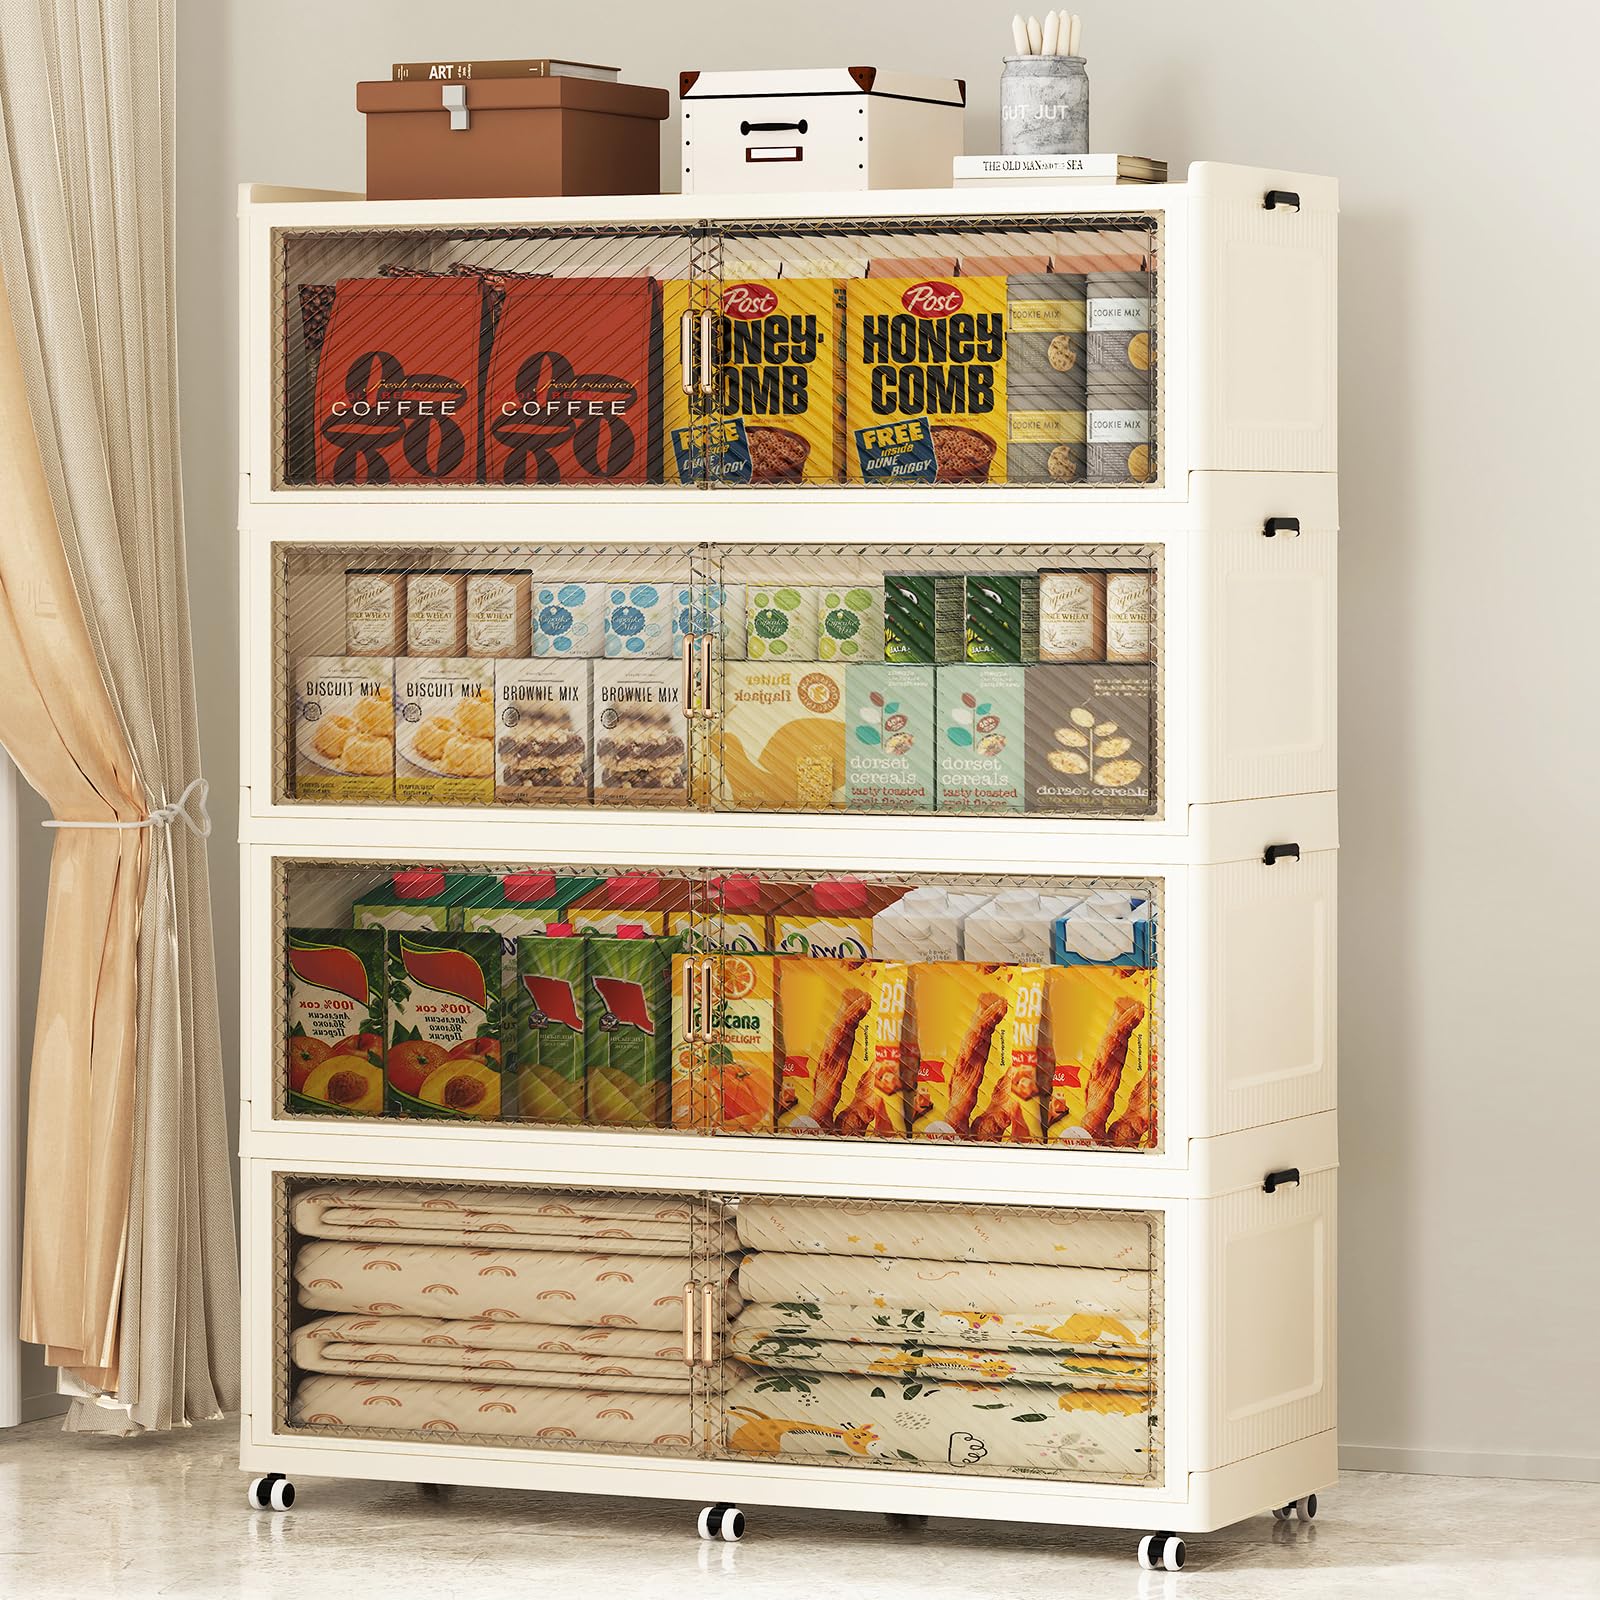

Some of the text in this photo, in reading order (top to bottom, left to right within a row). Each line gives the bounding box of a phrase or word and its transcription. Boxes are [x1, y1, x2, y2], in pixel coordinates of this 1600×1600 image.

[428, 65, 454, 79] ART
[1034, 104, 1069, 120] JUT
[983, 161, 1001, 171] THE
[1002, 160, 1021, 171] OLD
[1022, 160, 1041, 171] MAN
[1066, 159, 1084, 170] SEA
[724, 288, 775, 313] Post
[907, 286, 960, 312] Post
[1013, 311, 1060, 319] COOKIE MIX
[1094, 309, 1141, 317] COOKIE MIX
[363, 379, 470, 392] fresh roasted
[533, 379, 640, 392] fresh roasted
[871, 365, 995, 415] COMB
[332, 401, 456, 416] COFFEE
[502, 401, 626, 416] COFFEE
[1012, 421, 1060, 430] COOKIE MIX
[1094, 420, 1141, 429] COOKIE MIX
[862, 421, 924, 449] FREE
[881, 443, 914, 457] inside
[866, 455, 900, 471] DUNE
[891, 459, 932, 476] BUGGY
[365, 611, 391, 619] WHEAT
[426, 612, 452, 620] WHEAT
[306, 681, 381, 697] BISCUIT MIX
[406, 682, 482, 698] BISCUIT MIX
[503, 685, 579, 701] BROWNIE MIX
[602, 686, 679, 703] BROWNIE MIX
[850, 756, 909, 770] dorset
[941, 757, 1002, 771] dorset
[850, 771, 917, 785] cereals
[941, 772, 1009, 786] cereals
[851, 786, 926, 798] tasty toasted
[943, 787, 1018, 798] tasty toasted
[1036, 786, 1149, 797] dorset cereals
[725, 1035, 761, 1044] DELIGHT
